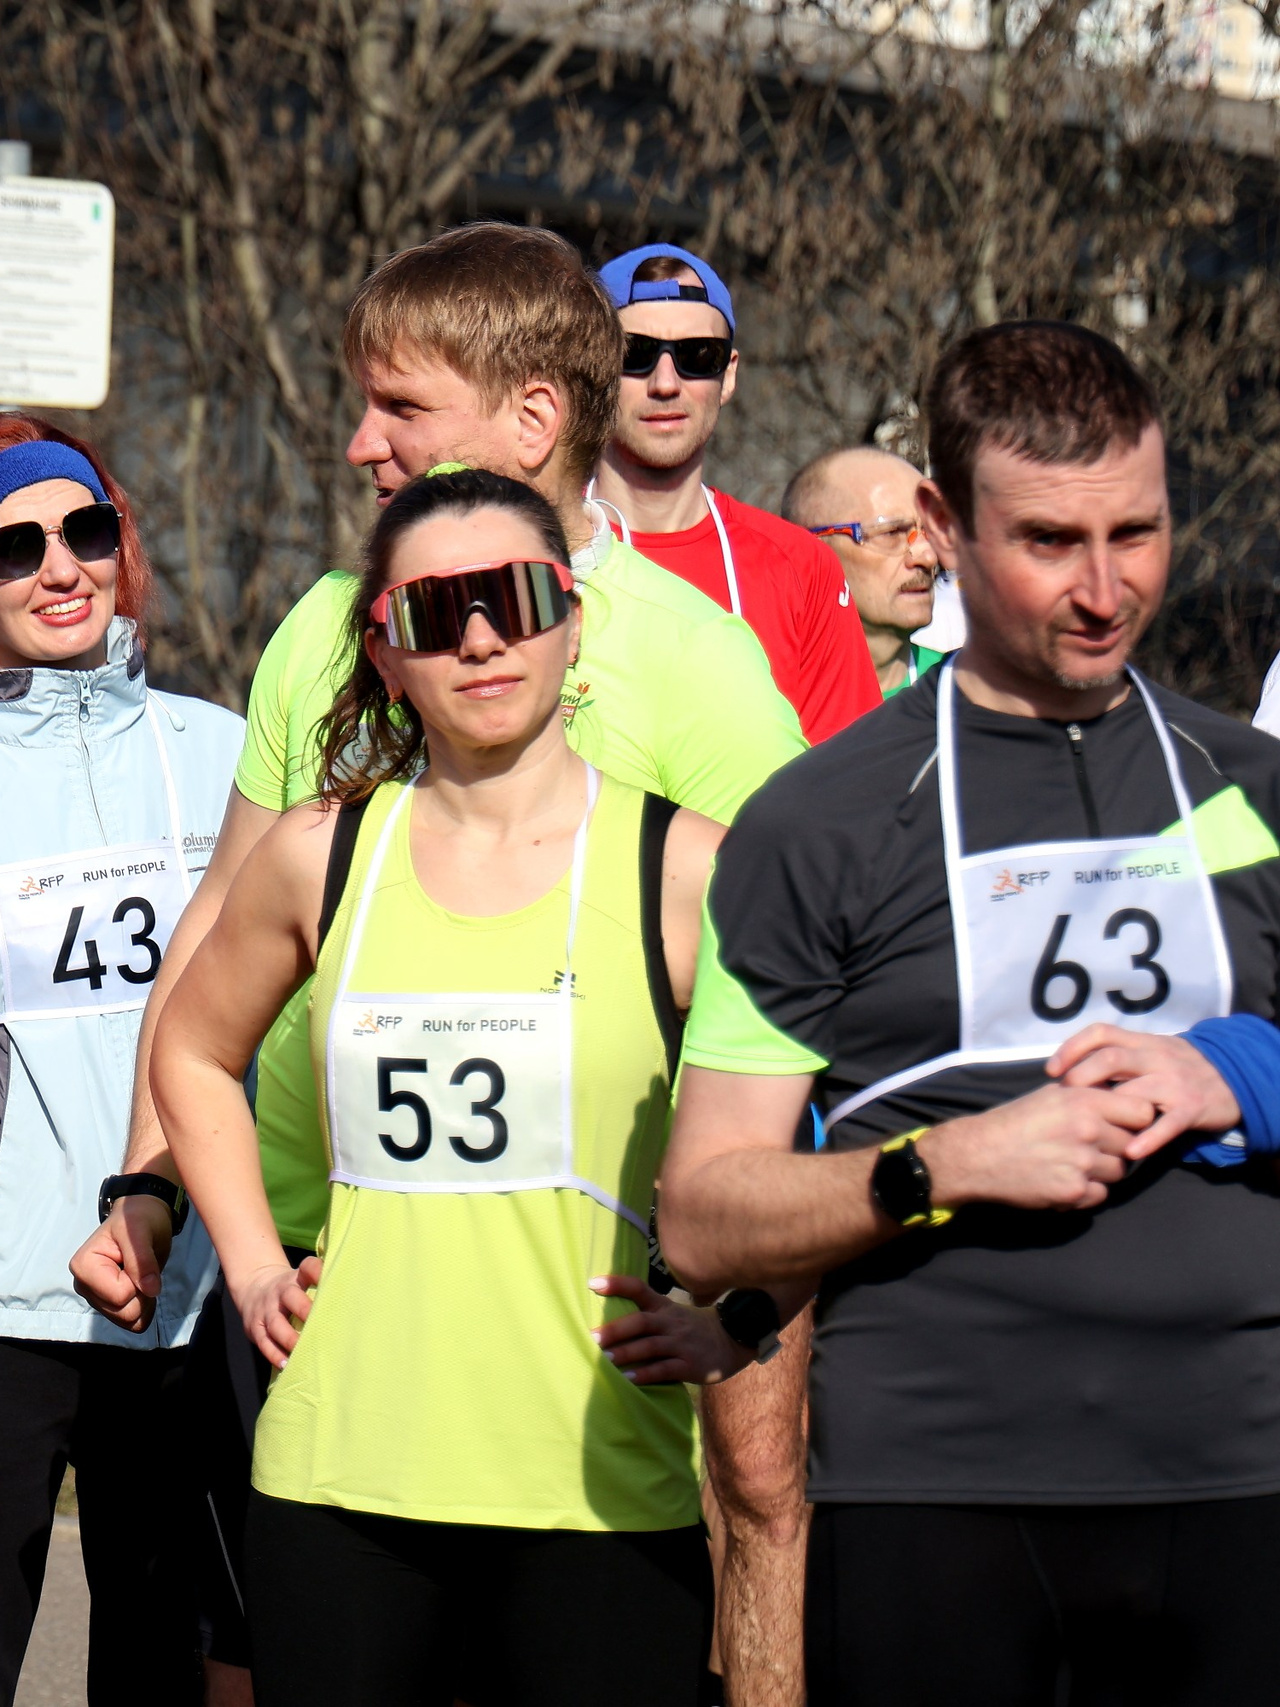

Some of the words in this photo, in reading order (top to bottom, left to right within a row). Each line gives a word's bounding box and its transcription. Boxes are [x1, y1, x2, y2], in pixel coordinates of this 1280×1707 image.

[39, 874, 64, 889] RFP
[82, 869, 108, 882] RUN
[111, 867, 125, 878] for
[127, 860, 166, 875] PEOPLE
[1017, 871, 1050, 887] RFP
[1075, 870, 1102, 884] RUN
[1105, 869, 1123, 882] for
[1127, 862, 1181, 879] PEOPLE
[53, 896, 162, 990] 43
[1030, 907, 1171, 1024] 63
[376, 1015, 403, 1030] RFP
[422, 1020, 453, 1031] RUN
[457, 1020, 476, 1031] for
[481, 1019, 536, 1031] PEOPLE
[377, 1056, 509, 1164] 53
